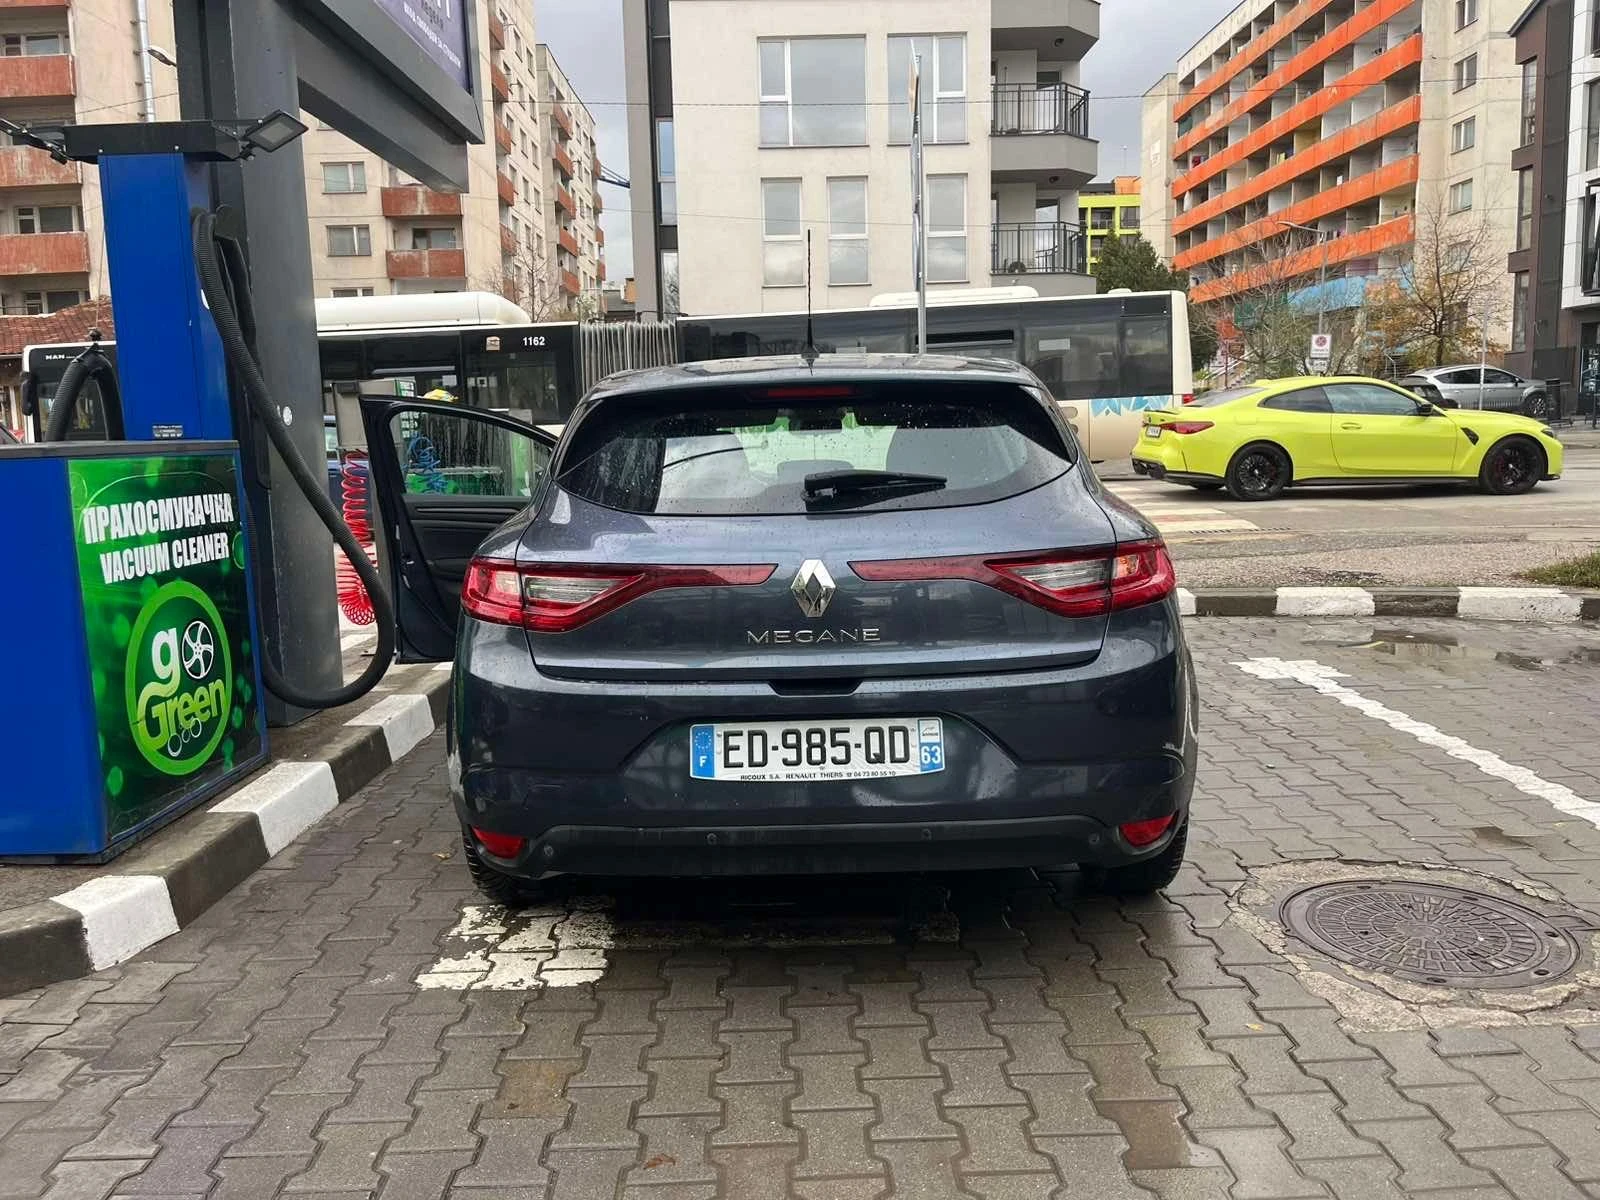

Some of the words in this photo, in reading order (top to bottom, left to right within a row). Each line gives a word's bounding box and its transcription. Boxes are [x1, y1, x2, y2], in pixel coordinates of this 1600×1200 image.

[522, 336, 546, 346] 1162
[82, 493, 234, 544] ПРАХОСМУКАЧКА
[100, 542, 171, 585] VACUUM
[172, 532, 230, 569] CLEANER
[746, 628, 881, 643] MEGANE
[137, 679, 226, 750] Green
[699, 755, 708, 768] F
[723, 726, 910, 768] ED-985-QD
[920, 745, 941, 764] 63
